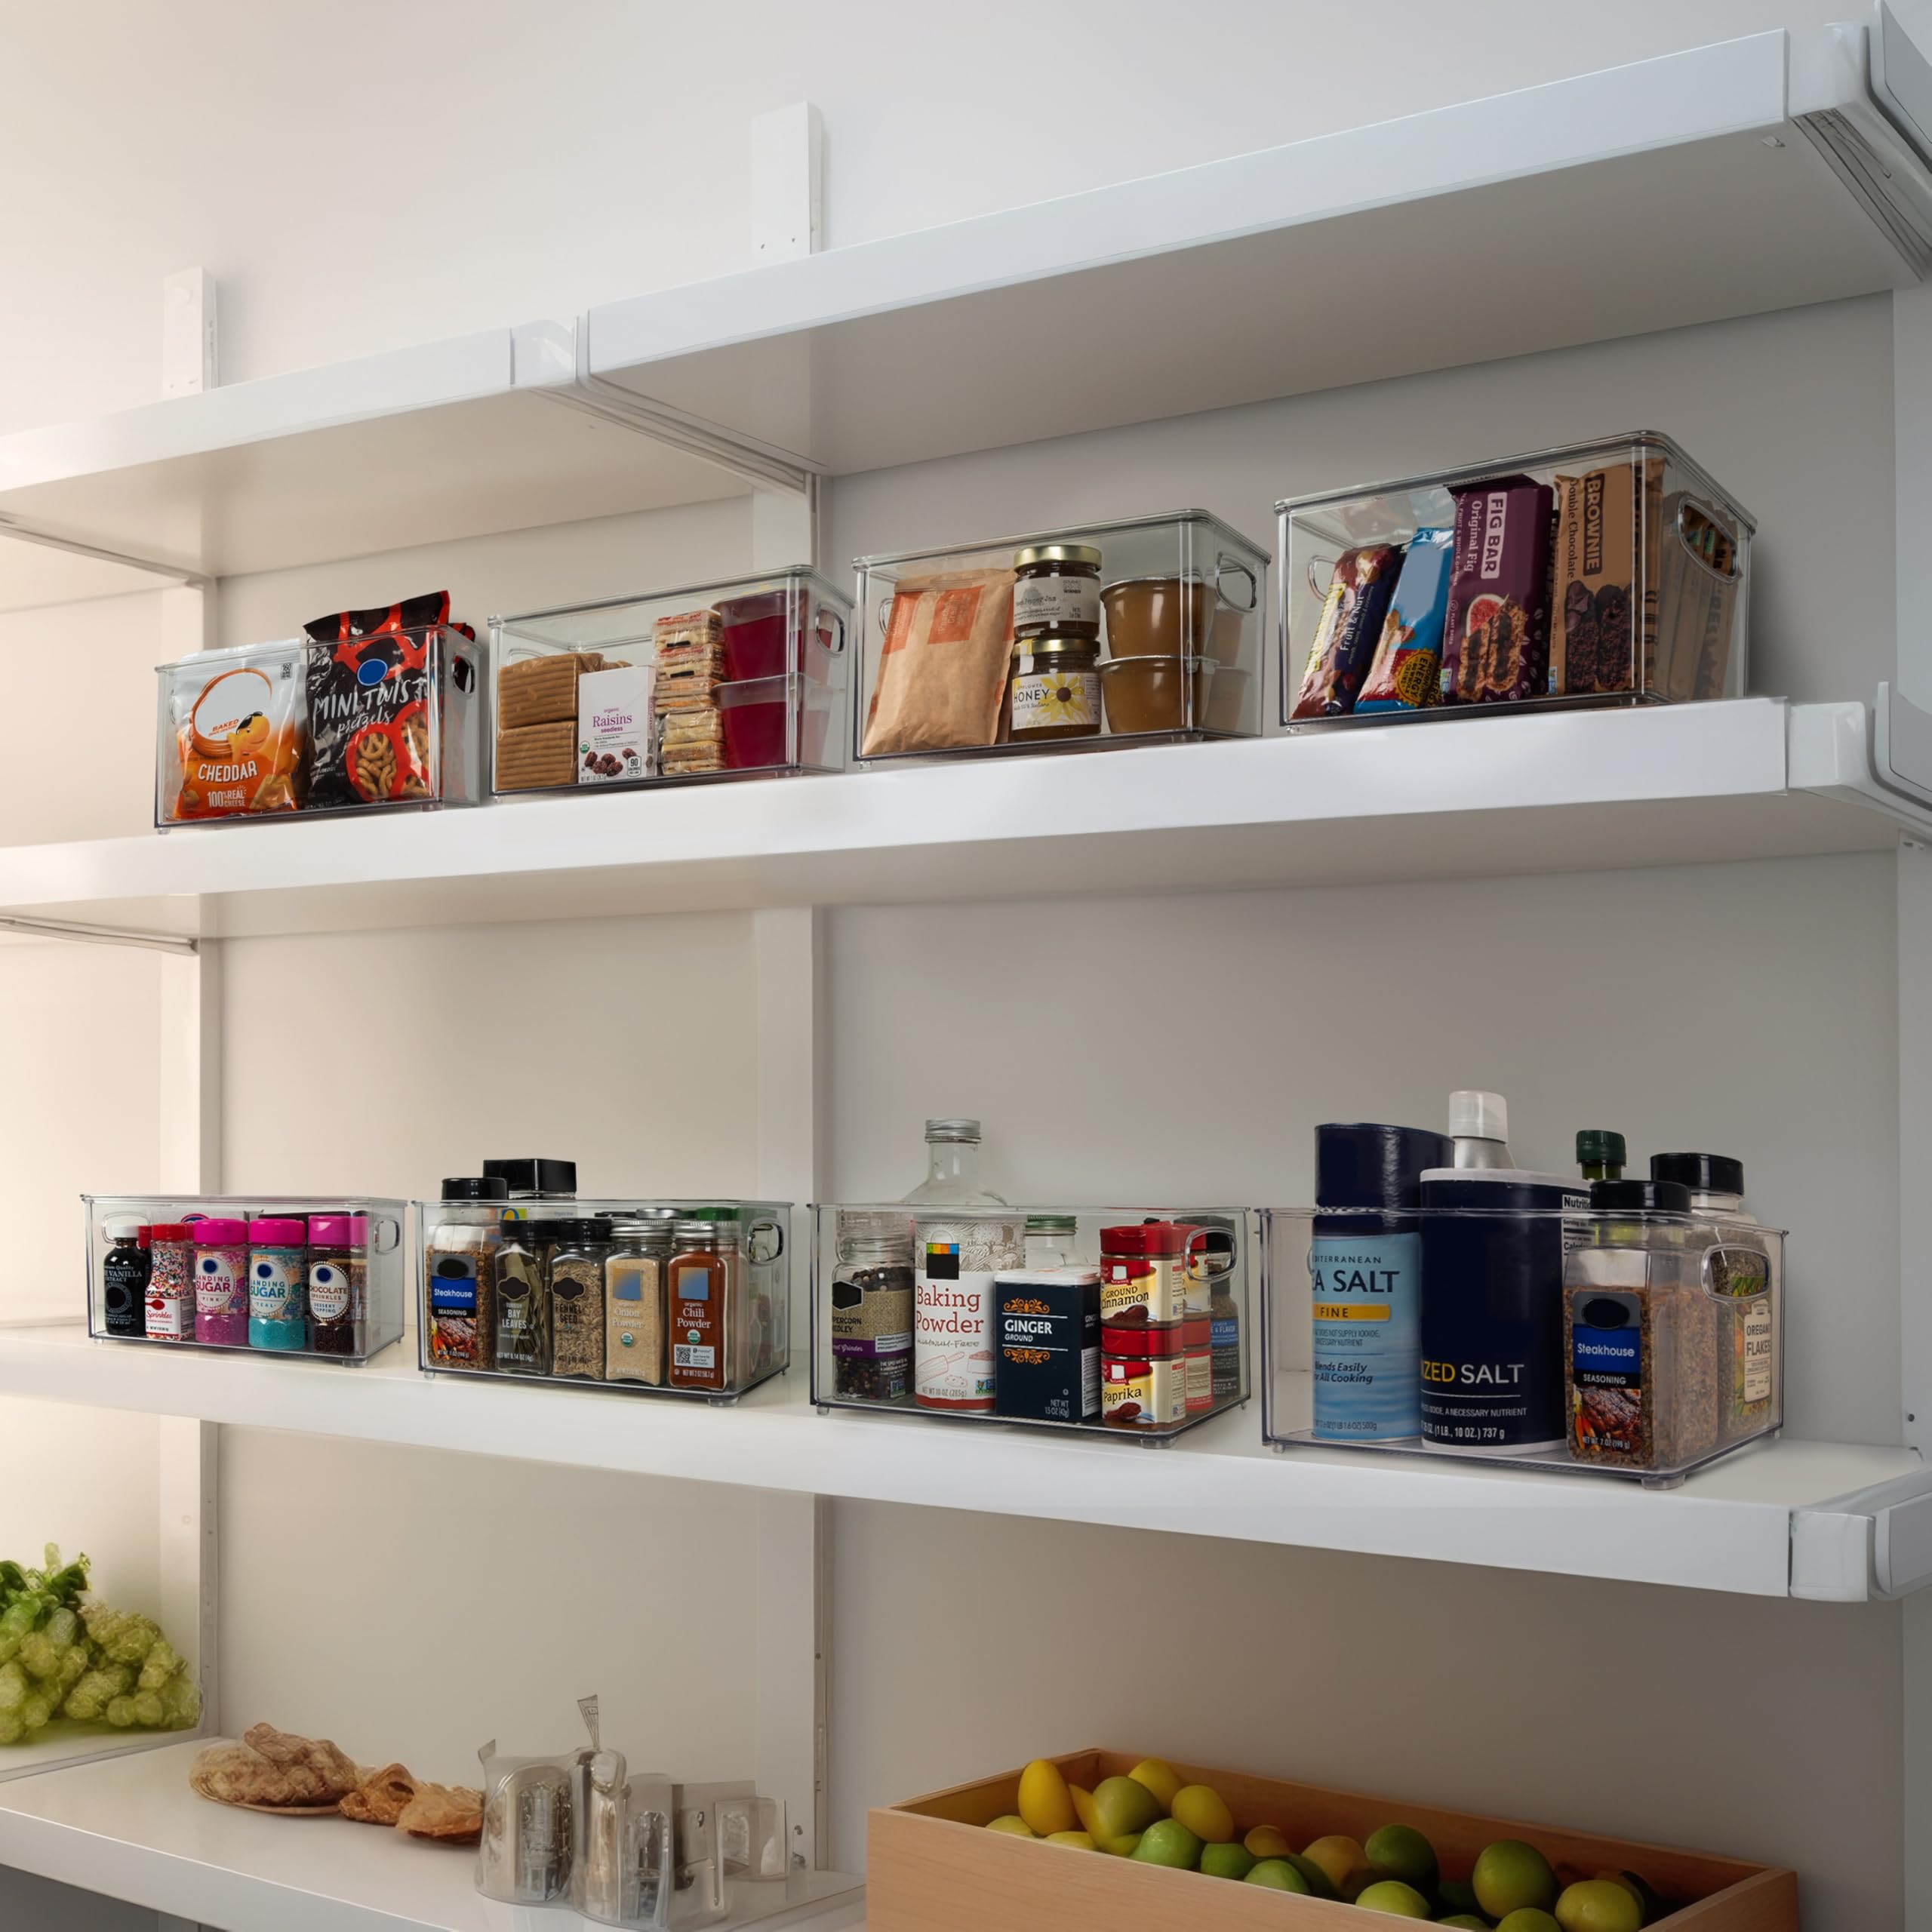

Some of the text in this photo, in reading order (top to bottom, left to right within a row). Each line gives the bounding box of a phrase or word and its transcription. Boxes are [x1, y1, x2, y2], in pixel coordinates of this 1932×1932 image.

[1567, 478, 1579, 579] Double Chocolate
[1586, 478, 1603, 571] BROWNIE
[1463, 500, 1483, 573] Original Fig
[1484, 498, 1504, 573] FIG BAR
[1340, 626, 1356, 651] Fruit
[1352, 595, 1364, 614] Nut
[1410, 657, 1429, 698] ENERGY
[1014, 688, 1050, 704] HONEY
[313, 684, 358, 721] MINI
[212, 719, 238, 732] BAKED
[337, 706, 394, 737] pretzels
[592, 713, 632, 728] Raisins
[630, 758, 638, 767] 90
[198, 761, 257, 783] CHEDDAR
[227, 789, 245, 800] REAL
[224, 799, 246, 808] CHEESE
[1314, 1256, 1382, 1264] DITERRANEAN
[196, 1280, 230, 1292] SUGAR
[251, 1279, 285, 1287] ANDING
[1333, 1269, 1400, 1293] SALT
[250, 1286, 285, 1298] SUGAR
[434, 1287, 473, 1298] Steakhouse
[1106, 1286, 1138, 1299] GROUND
[917, 1284, 981, 1313] Baking
[1101, 1291, 1149, 1309] Cinnamon
[146, 1310, 172, 1319] Sprinkles
[507, 1309, 521, 1318] BAY
[555, 1303, 582, 1314] FENNEL
[614, 1308, 640, 1318] Onion
[682, 1307, 705, 1318] Chili
[1320, 1307, 1349, 1318] FINE
[502, 1318, 527, 1329] LEAVES
[560, 1315, 578, 1324] SEED
[612, 1318, 642, 1328] Powder
[677, 1318, 712, 1329] Powder
[916, 1310, 984, 1334] Powder
[1004, 1318, 1053, 1334] GINGER
[1004, 1334, 1033, 1343] GROUND
[1338, 1329, 1358, 1338] SUPPLY
[1337, 1339, 1363, 1347] NUTRIENT
[1746, 1340, 1771, 1357] FLAKES
[1577, 1343, 1635, 1357] Steakhouse
[1337, 1361, 1367, 1374] Easily
[1319, 1373, 1373, 1386] All Cooking
[1460, 1364, 1524, 1384] SALT
[1583, 1374, 1626, 1385] SEASONING
[928, 1387, 935, 1395] WT
[941, 1388, 948, 1397] OZ
[1103, 1386, 1142, 1404] Paprika
[1051, 1399, 1060, 1407] NET
[1051, 1407, 1058, 1416] OZ
[1450, 1407, 1489, 1417] NECESSARY
[1491, 1407, 1527, 1417] NUTRIENT
[1361, 1423, 1377, 1432] 500g
[1455, 1426, 1463, 1438] 10
[1465, 1427, 1481, 1440] OZ.)
[1482, 1427, 1497, 1438] 737
[1499, 1429, 1505, 1439] g
